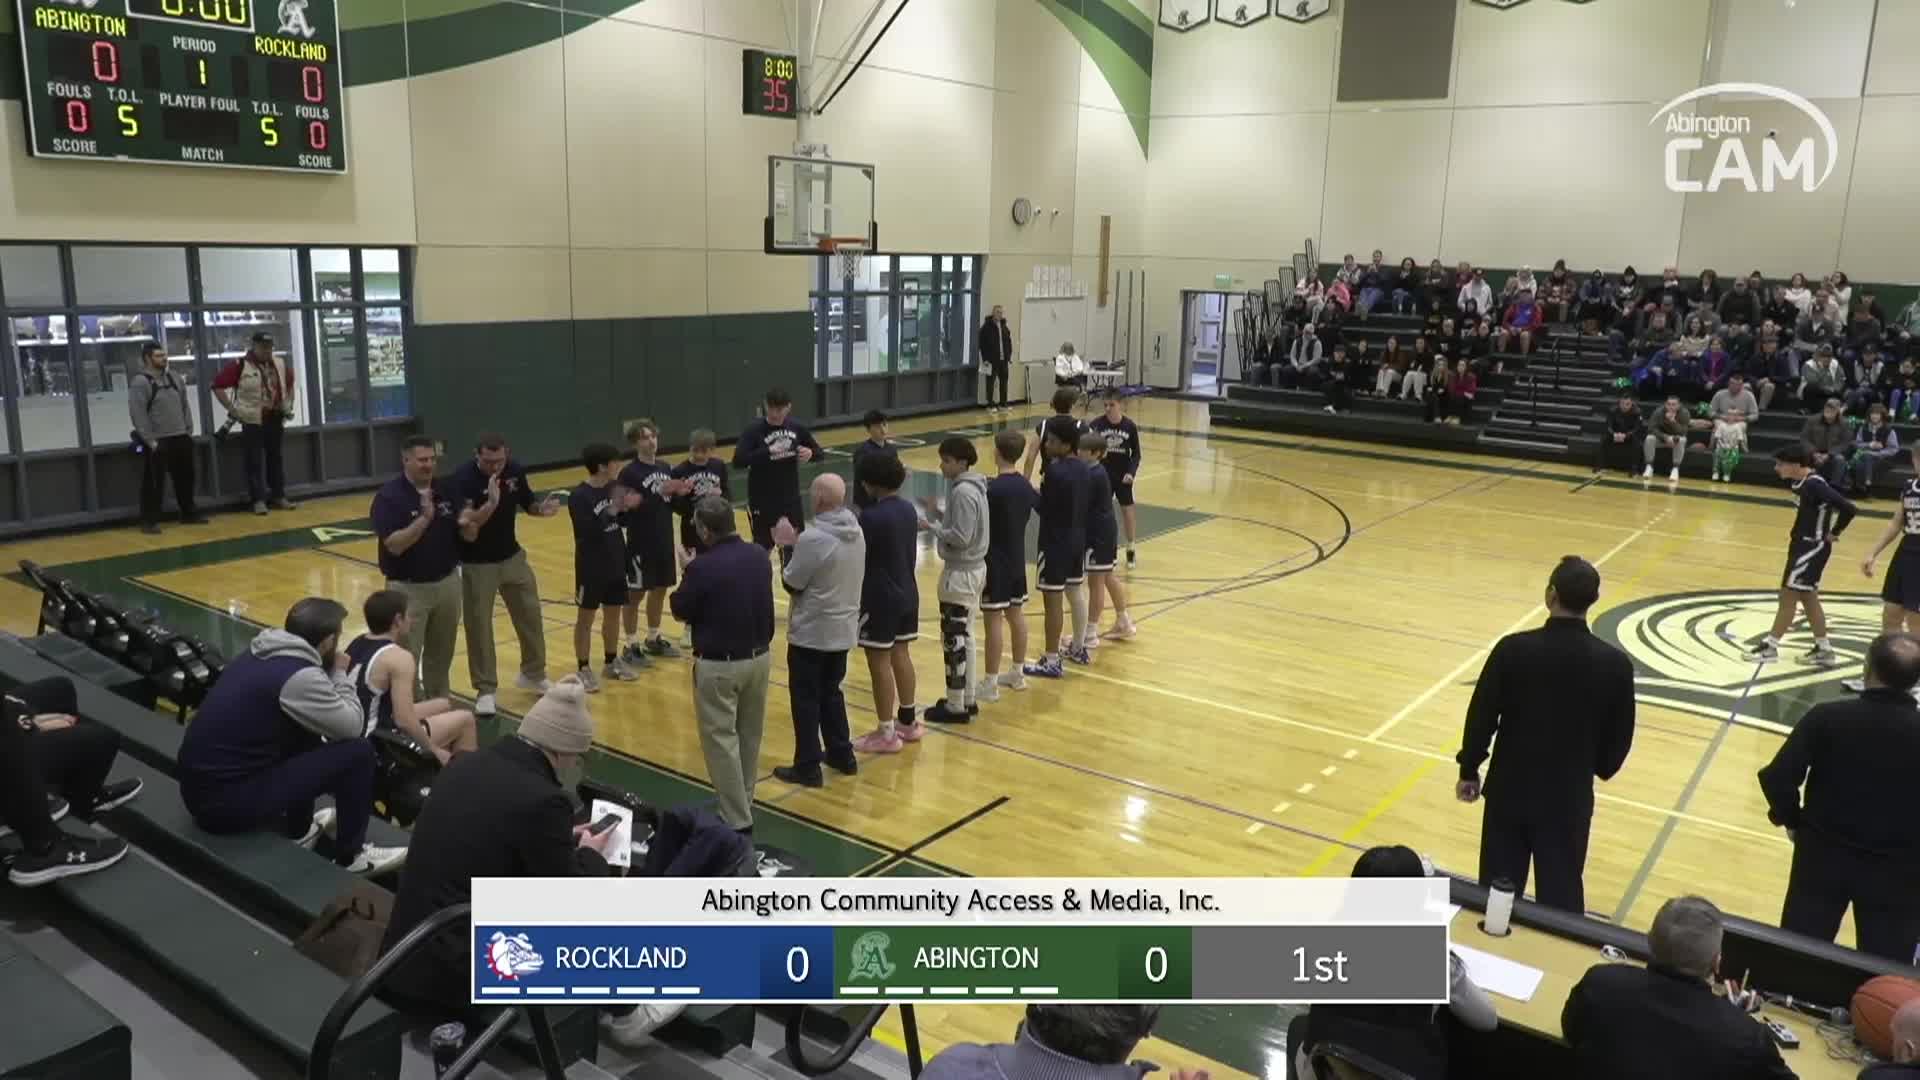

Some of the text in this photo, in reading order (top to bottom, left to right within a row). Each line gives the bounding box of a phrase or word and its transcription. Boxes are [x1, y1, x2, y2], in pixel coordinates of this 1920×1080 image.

[35, 7, 127, 37] ABINGTON
[173, 36, 216, 53] PERIOD
[255, 35, 327, 62] ROCKLAND
[92, 41, 118, 82] 0
[199, 59, 206, 85] 1
[765, 57, 793, 80] 8:00
[47, 82, 92, 99] FOULS
[107, 87, 143, 104] T.O.L.
[303, 66, 322, 103] 0
[763, 79, 788, 112] 35
[160, 93, 240, 112] PLAYER FOUL
[252, 101, 283, 116] T.O.L.
[296, 105, 329, 120] FOULS
[67, 100, 88, 133] 0
[118, 104, 138, 137] 5
[261, 117, 278, 146] 5
[310, 121, 326, 149] 0
[53, 138, 97, 154] SCORE
[181, 146, 224, 162] MATCH
[298, 154, 332, 168] SCORE
